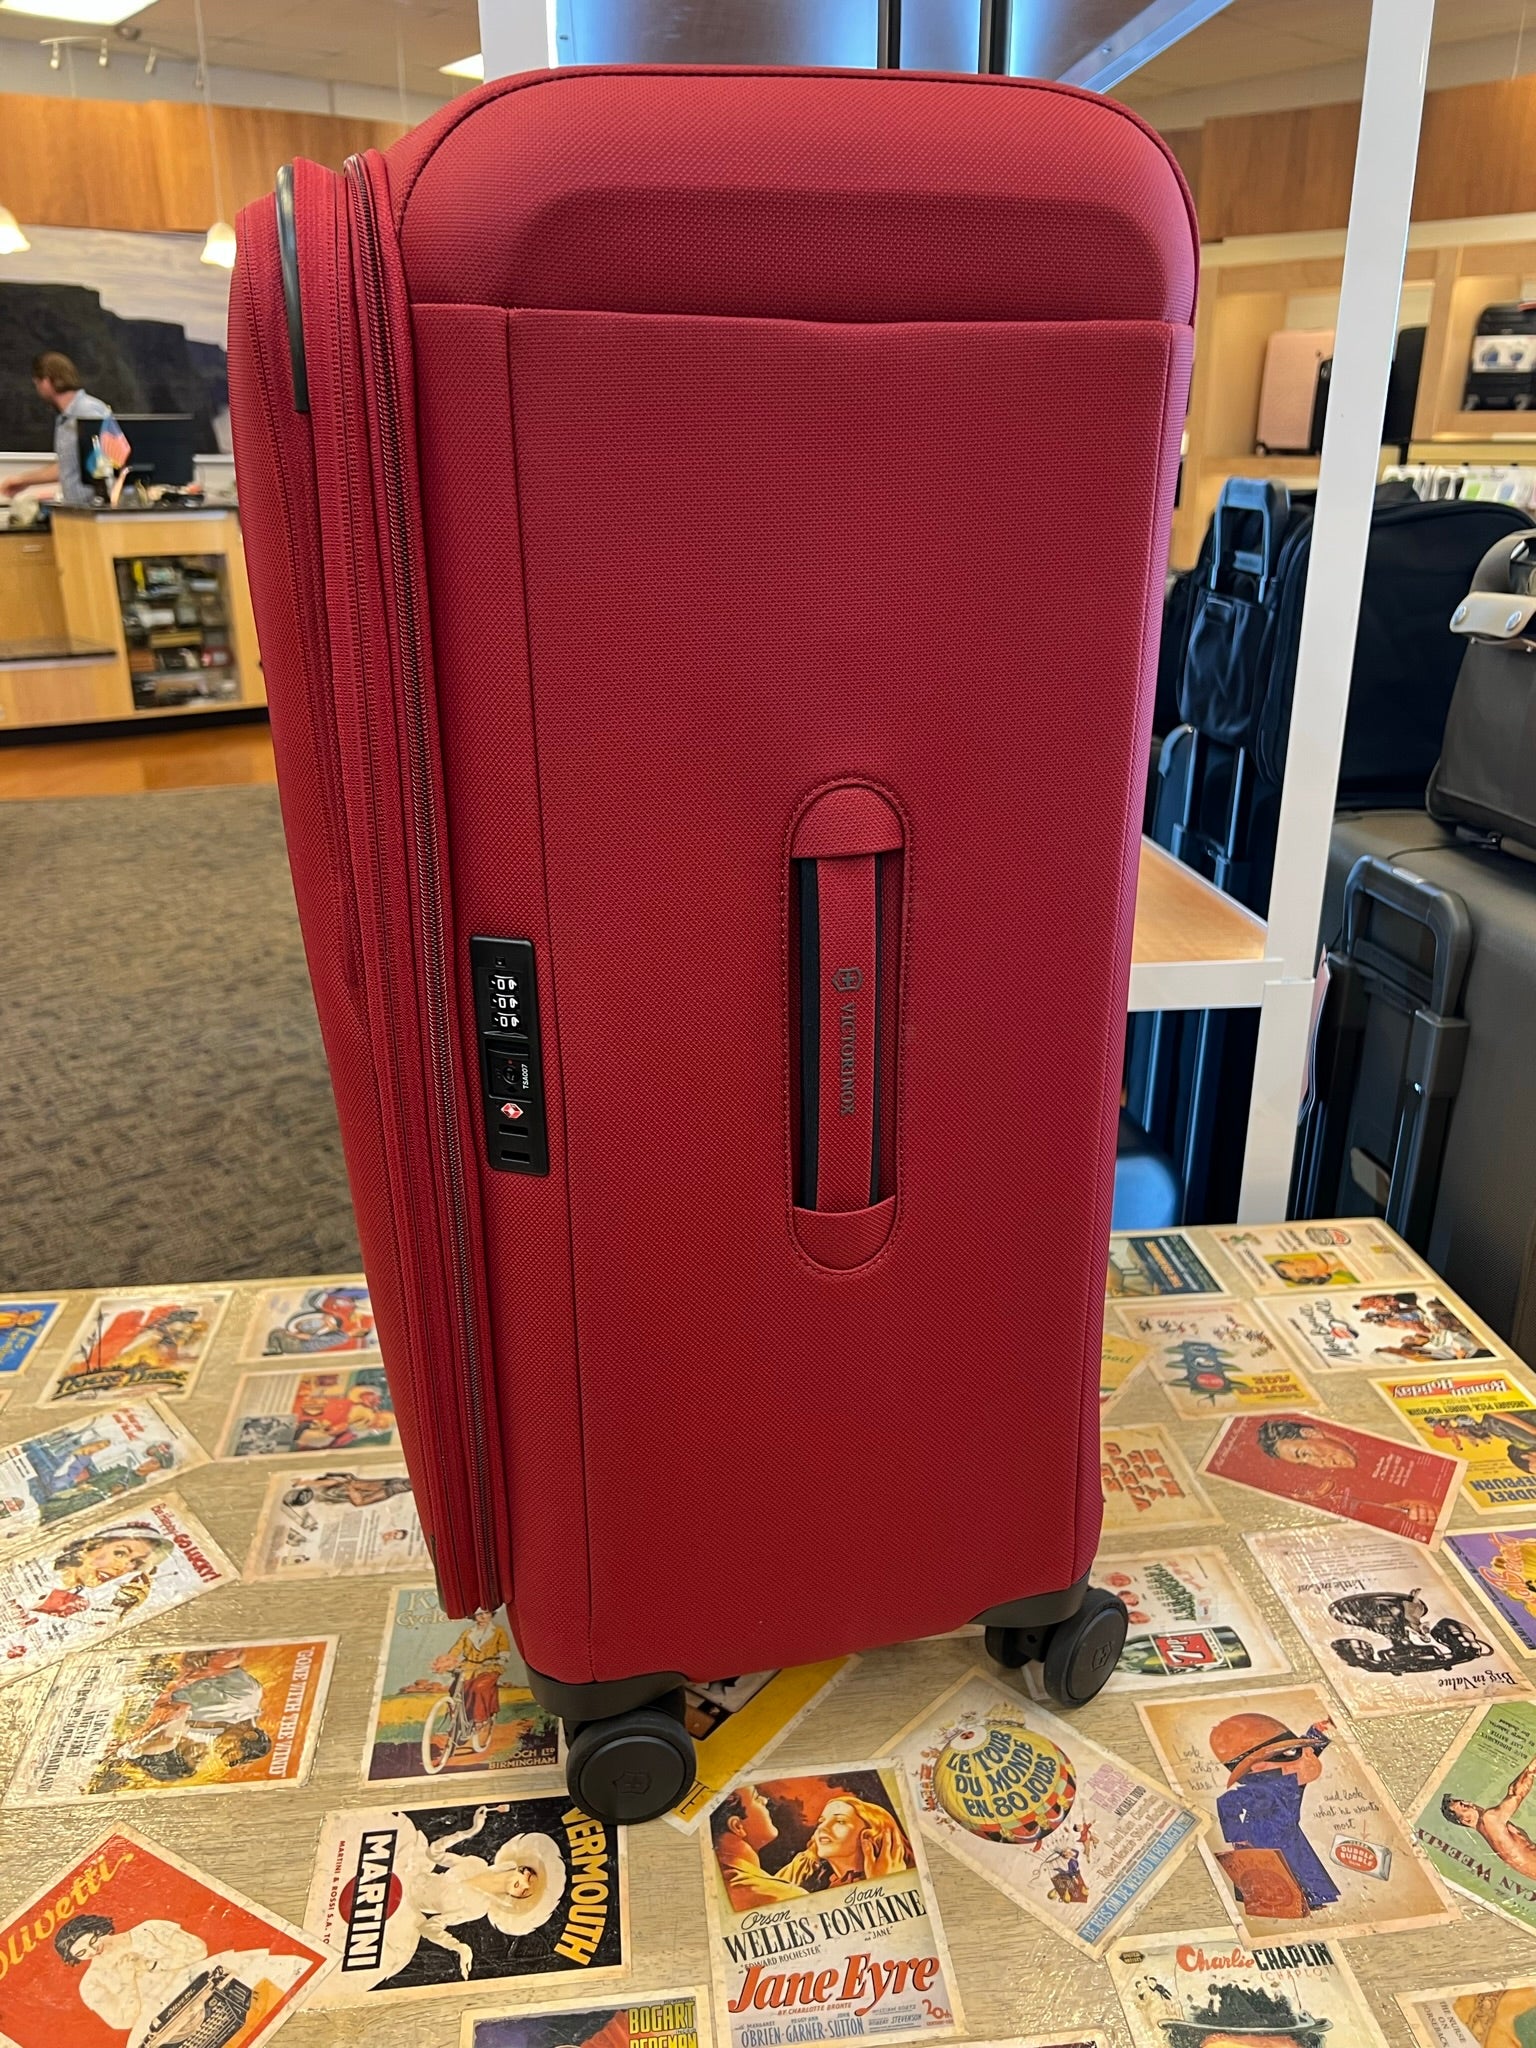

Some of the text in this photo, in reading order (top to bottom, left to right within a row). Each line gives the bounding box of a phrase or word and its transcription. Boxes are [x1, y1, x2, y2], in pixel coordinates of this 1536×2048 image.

[840, 1002, 856, 1116] VICTORINOX
[1393, 1378, 1454, 1399] Holiday
[1451, 1380, 1507, 1397] Roman
[1469, 1476, 1536, 1491] EPBURN
[1487, 1488, 1536, 1503] UDREY
[184, 1545, 222, 1583] LUCKY!
[396, 1610, 453, 1629] Cycle
[1437, 1676, 1478, 1691] Value
[1484, 1669, 1517, 1687] Big
[284, 1681, 307, 1713] WITH
[277, 1713, 299, 1740] THE
[511, 1749, 537, 1759] OCH
[946, 1730, 1012, 1774] LE TOUR
[488, 1757, 556, 1770] BIRMINGHAM
[955, 1739, 1033, 1797] DU MONDE
[962, 1753, 1057, 1819] EN 80 JOURS
[1324, 1790, 1342, 1801] and
[1113, 1783, 1147, 1819] MICHAEL TODD
[1313, 1805, 1336, 1818] what
[1340, 1806, 1351, 1815] he
[1159, 1821, 1186, 1849] DAGEN
[334, 1840, 345, 1874] MARTINI
[1146, 1851, 1161, 1866] IN
[1151, 1840, 1170, 1858] 80
[1340, 1846, 1374, 1860] DUBBLE
[1340, 1852, 1374, 1867] BUBBLE
[1413, 1827, 1492, 1883] WEEKLY
[1122, 1857, 1155, 1892] WERELD
[554, 1807, 609, 1966] VERMOUTH
[844, 1886, 885, 1907] Joan
[1114, 1884, 1133, 1902] DE
[328, 1885, 338, 1911] ROSSI
[346, 1834, 393, 1967] MARTINI
[1104, 1894, 1123, 1914] OM
[722, 1889, 927, 1965] WELLES FONTAINE
[740, 1909, 791, 1930] Orson
[1089, 1906, 1114, 1931] REIS
[322, 1932, 331, 1945] TO
[1081, 1922, 1100, 1941] DE
[1176, 1942, 1335, 1972] Charlie CHAPLIN
[728, 1953, 940, 2016] Jane Eyre
[628, 2000, 695, 2035] BOGART
[788, 2005, 824, 2015] CHARLOTTE
[826, 2002, 852, 2011] BRONTE
[890, 2014, 922, 2024] STEVENSON
[922, 1998, 953, 2019] 20th
[741, 2027, 781, 2048] O'BRIEN
[785, 2021, 826, 2043] GARNER
[827, 2014, 865, 2038] SUTTON
[746, 2021, 775, 2030] MARGARET
[1438, 2016, 1449, 2030] ON
[1440, 2001, 1467, 2043] THE NURSE
